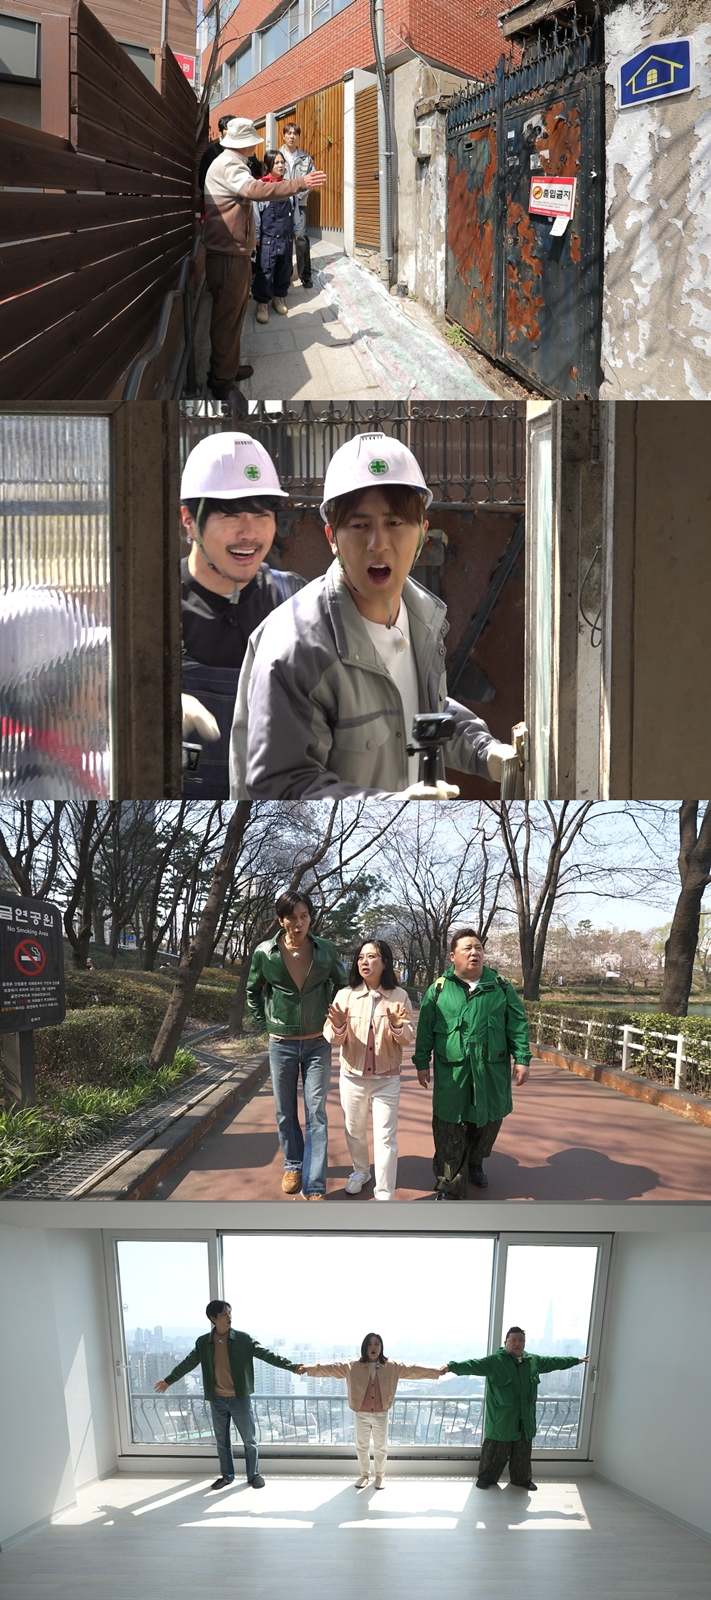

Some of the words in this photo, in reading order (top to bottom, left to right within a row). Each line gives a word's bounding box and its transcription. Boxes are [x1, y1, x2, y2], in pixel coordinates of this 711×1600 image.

[543, 189, 571, 200] 출입금지
[0, 905, 54, 927] 금연공원
[16, 927, 37, 936] Smoking
